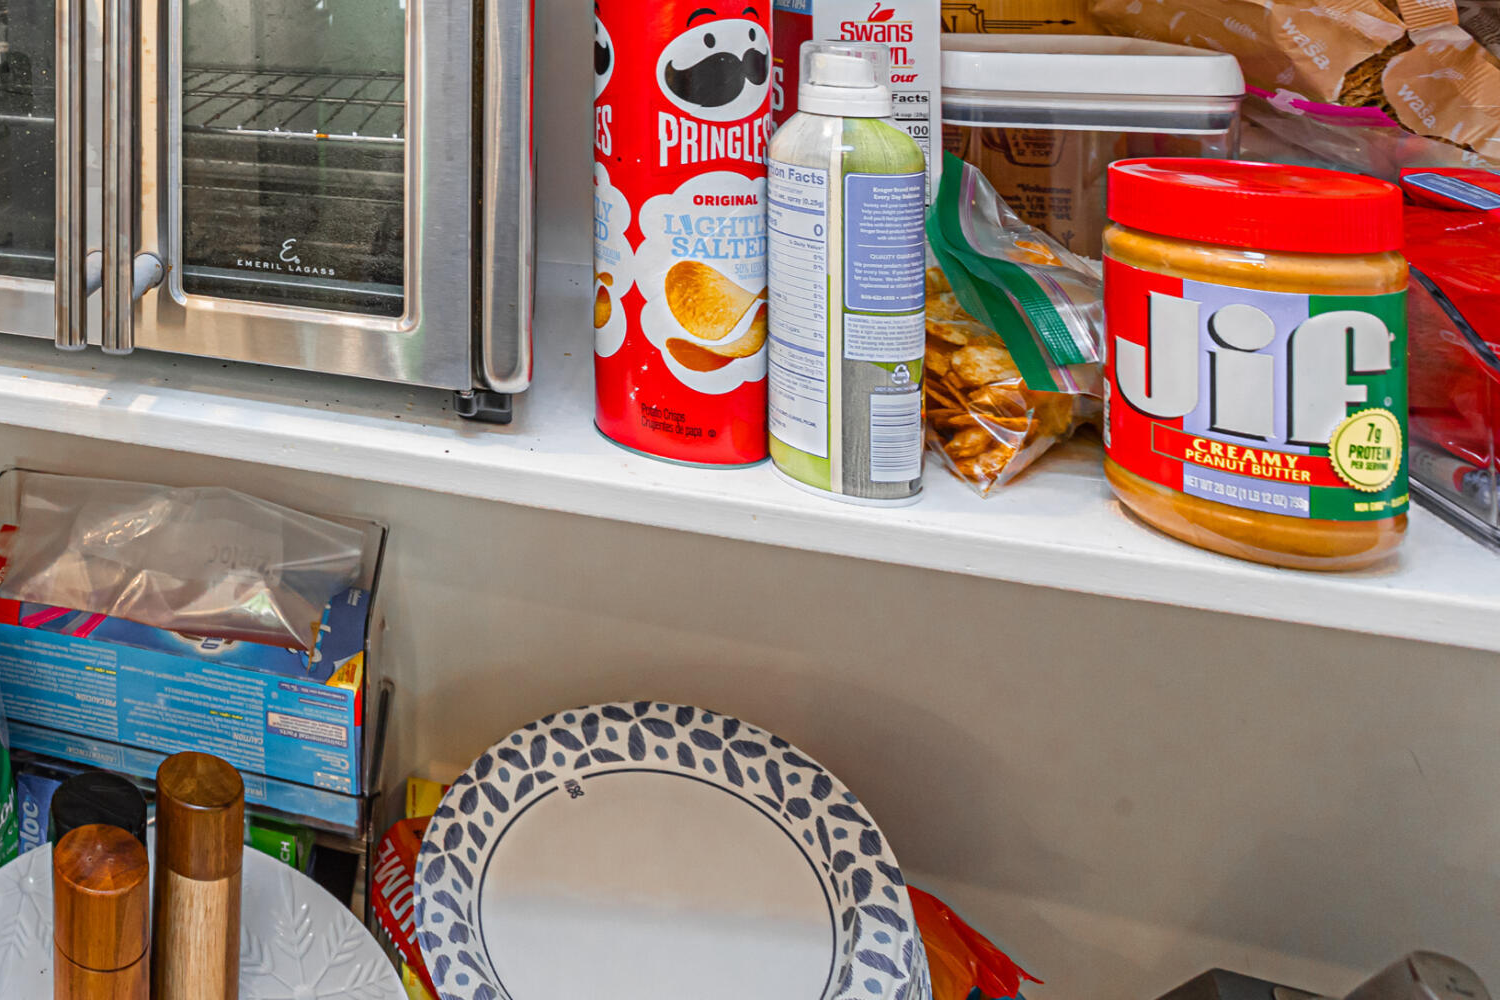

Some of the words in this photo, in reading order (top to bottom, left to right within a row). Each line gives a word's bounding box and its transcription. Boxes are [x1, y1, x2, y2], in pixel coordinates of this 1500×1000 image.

[840, 21, 914, 42] Swans
[1280, 16, 1332, 71] wasa
[891, 93, 928, 103] Facts
[1396, 82, 1437, 130] wasa
[905, 126, 929, 135] 100
[787, 168, 824, 186] Facts
[692, 194, 758, 206] ORIGINAL
[813, 224, 824, 237] 0
[671, 236, 768, 259] SALTED
[237, 259, 282, 270] EMERIL
[1115, 290, 1392, 446] Jif
[641, 403, 662, 418] Potato
[663, 408, 686, 423] Crisps
[675, 423, 684, 434] de
[1367, 423, 1382, 444] 7g
[1192, 438, 1299, 469] CREAMY
[1348, 444, 1392, 461] PROTEIN
[1185, 448, 1247, 473] PEANUT
[1251, 463, 1311, 482] BUTTER
[1350, 461, 1364, 470] PER
[1365, 462, 1388, 471] SERVING
[1226, 485, 1238, 497] OZ
[1249, 489, 1260, 502] LB
[1261, 491, 1271, 504] 12
[1272, 493, 1288, 508] OZ)
[232, 731, 264, 745] CAUTION:
[298, 732, 349, 748] Environmental
